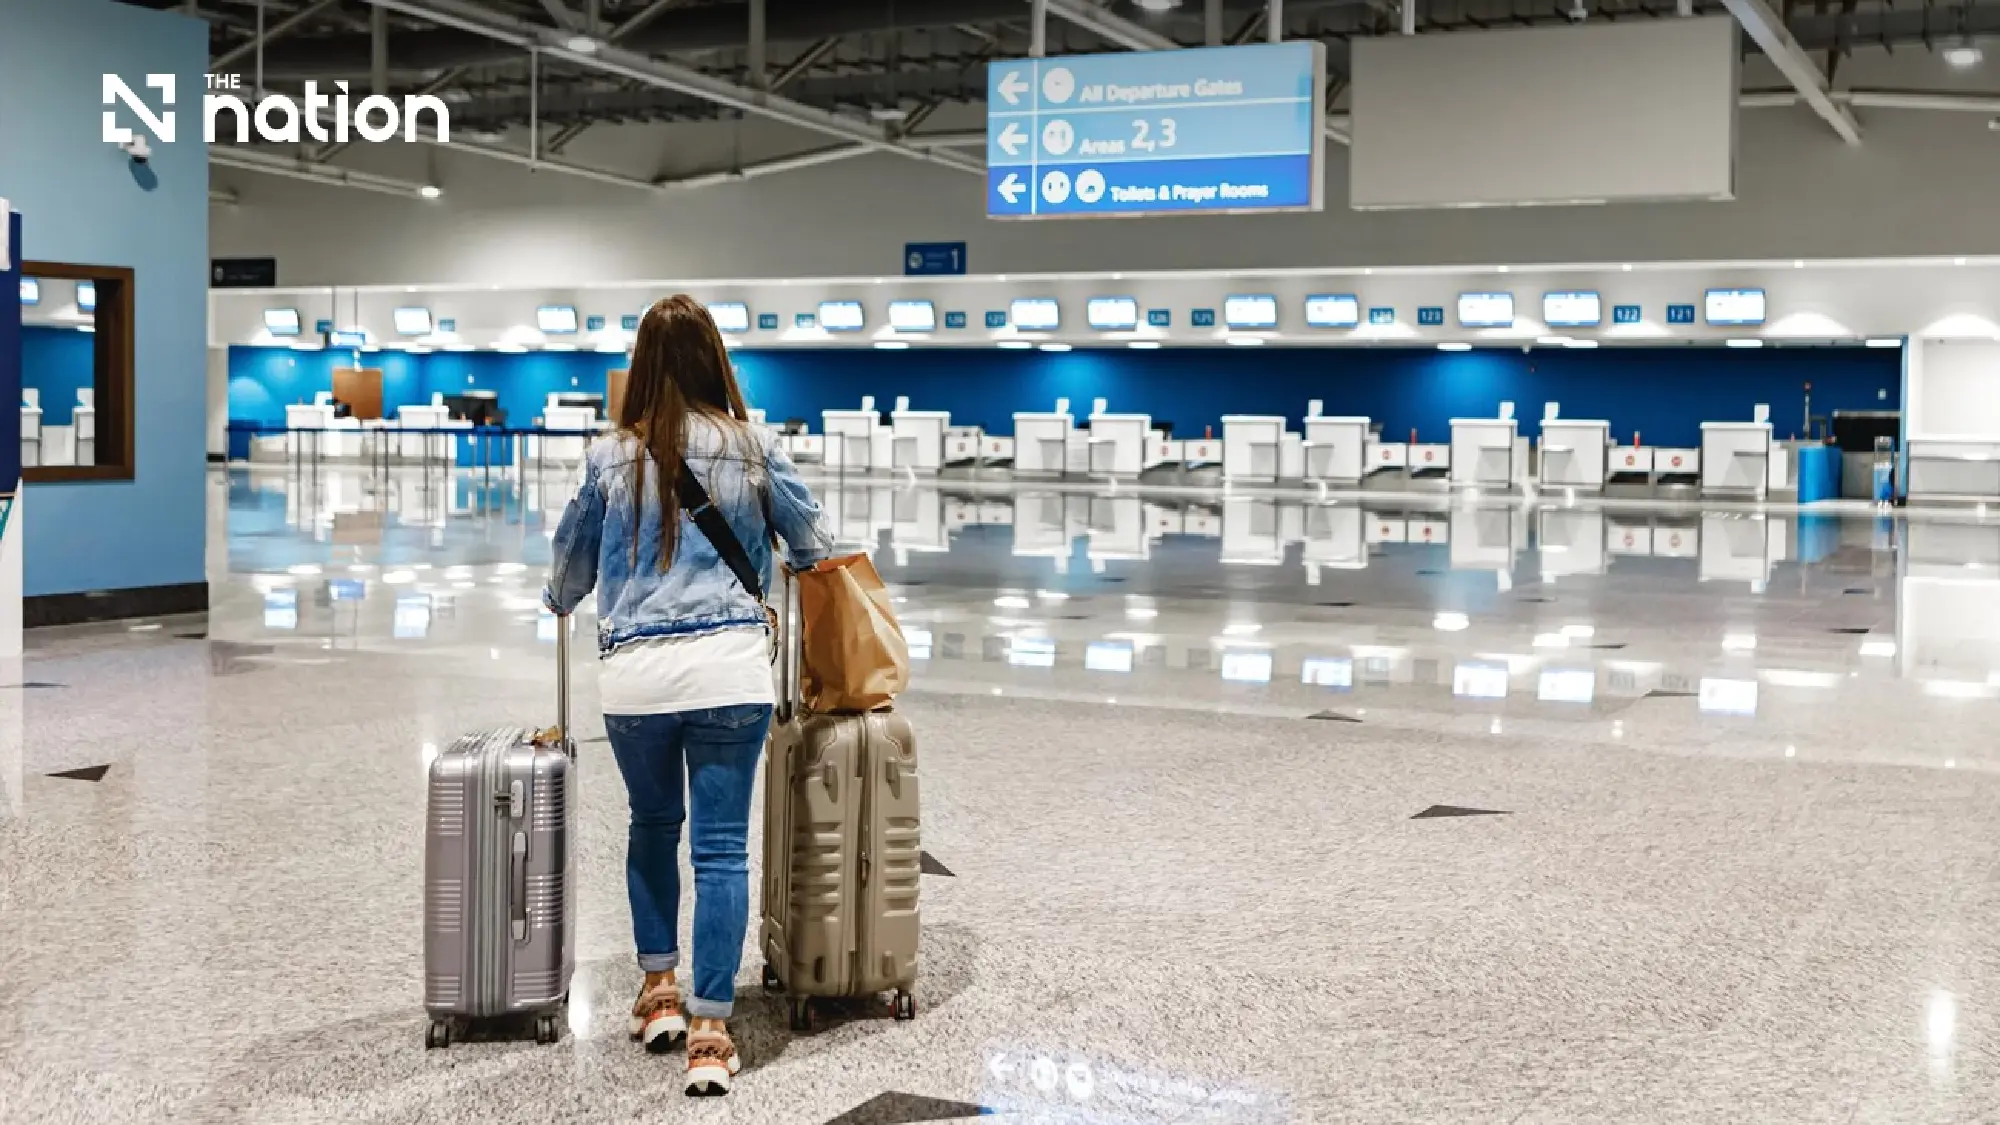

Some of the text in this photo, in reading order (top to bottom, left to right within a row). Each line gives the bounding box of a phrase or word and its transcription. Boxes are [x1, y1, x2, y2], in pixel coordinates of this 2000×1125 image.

[1080, 78, 1242, 103] All Departure Gates
[1080, 138, 1125, 154] Areas
[1111, 185, 1155, 202] Toilets
[1172, 185, 1217, 203] Prayer
[1220, 183, 1268, 198] Rooms
